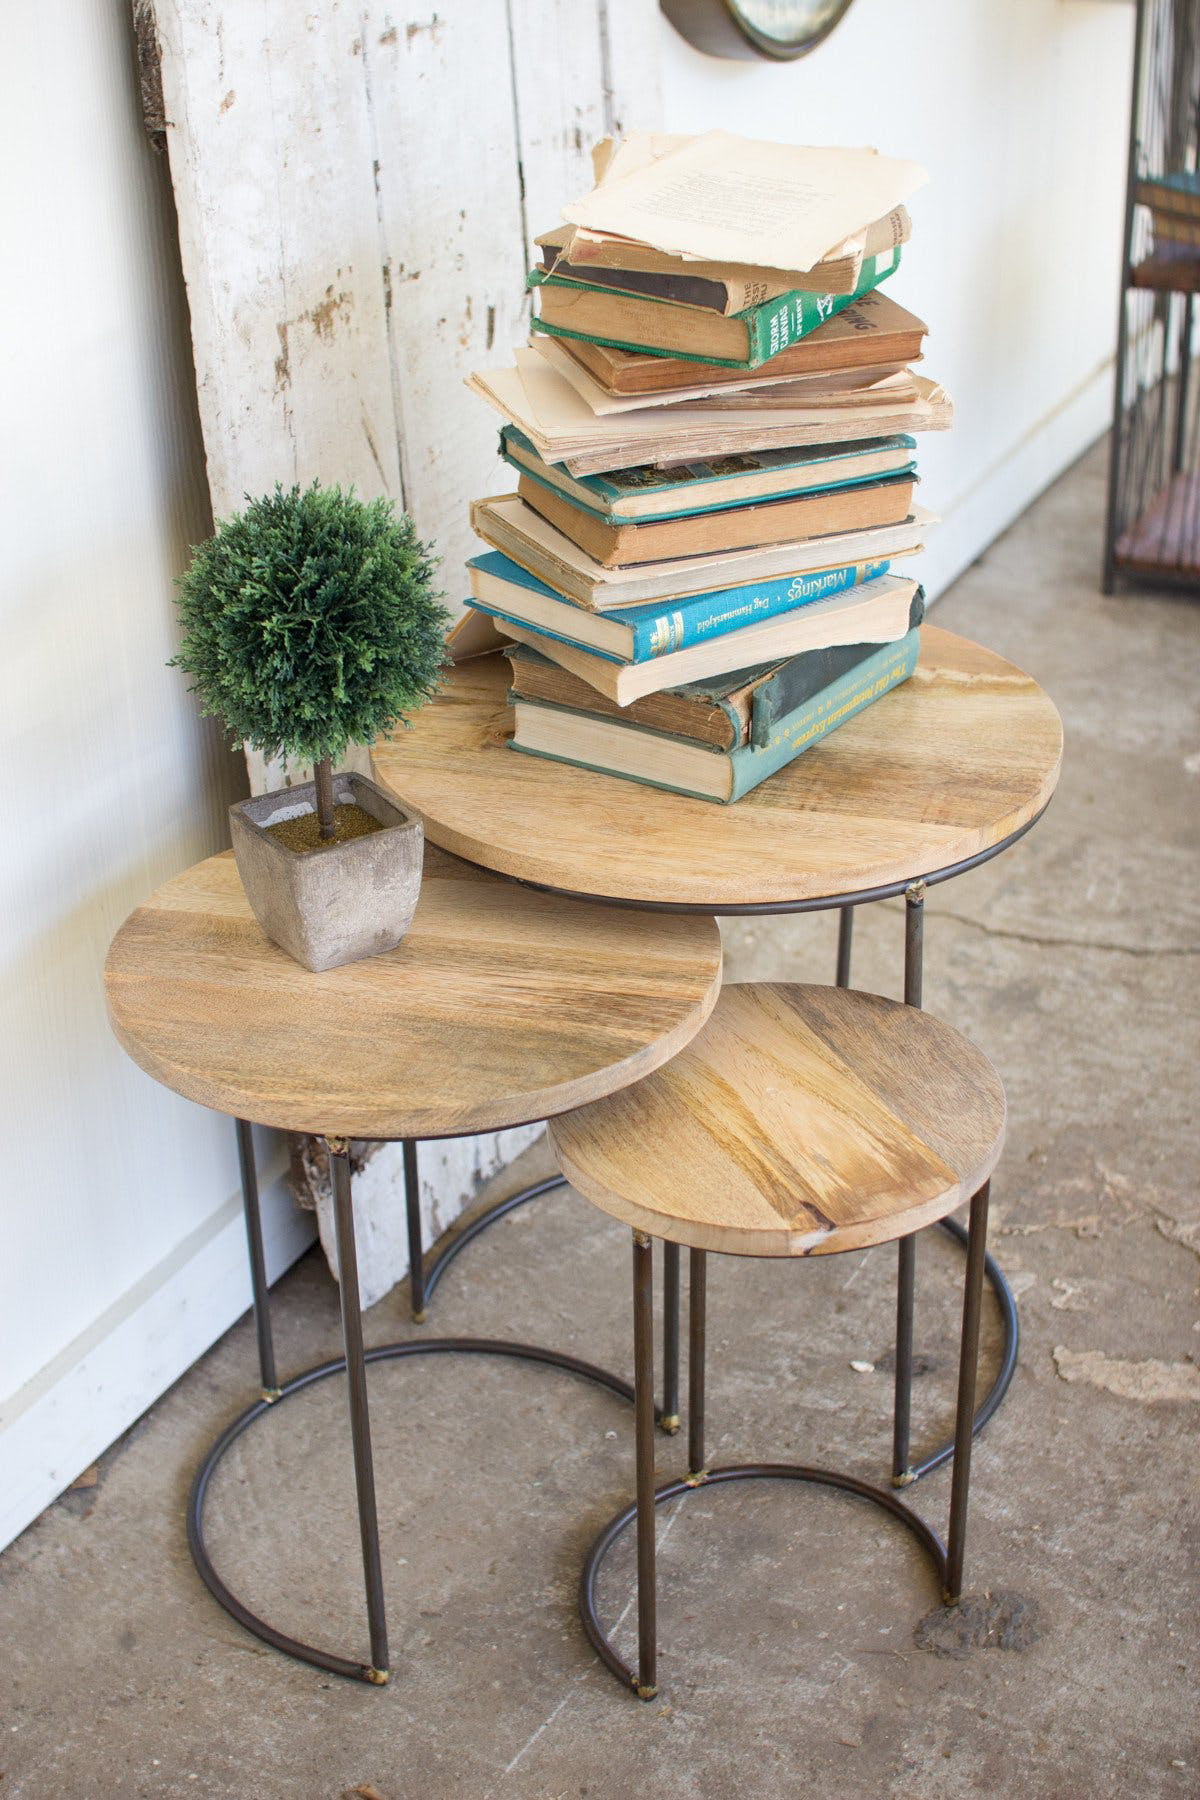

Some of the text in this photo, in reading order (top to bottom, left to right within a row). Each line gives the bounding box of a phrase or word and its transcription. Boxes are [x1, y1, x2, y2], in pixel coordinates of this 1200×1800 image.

[770, 313, 779, 355] STORM
[779, 304, 789, 349] CANVAS
[786, 569, 847, 602] Markings
